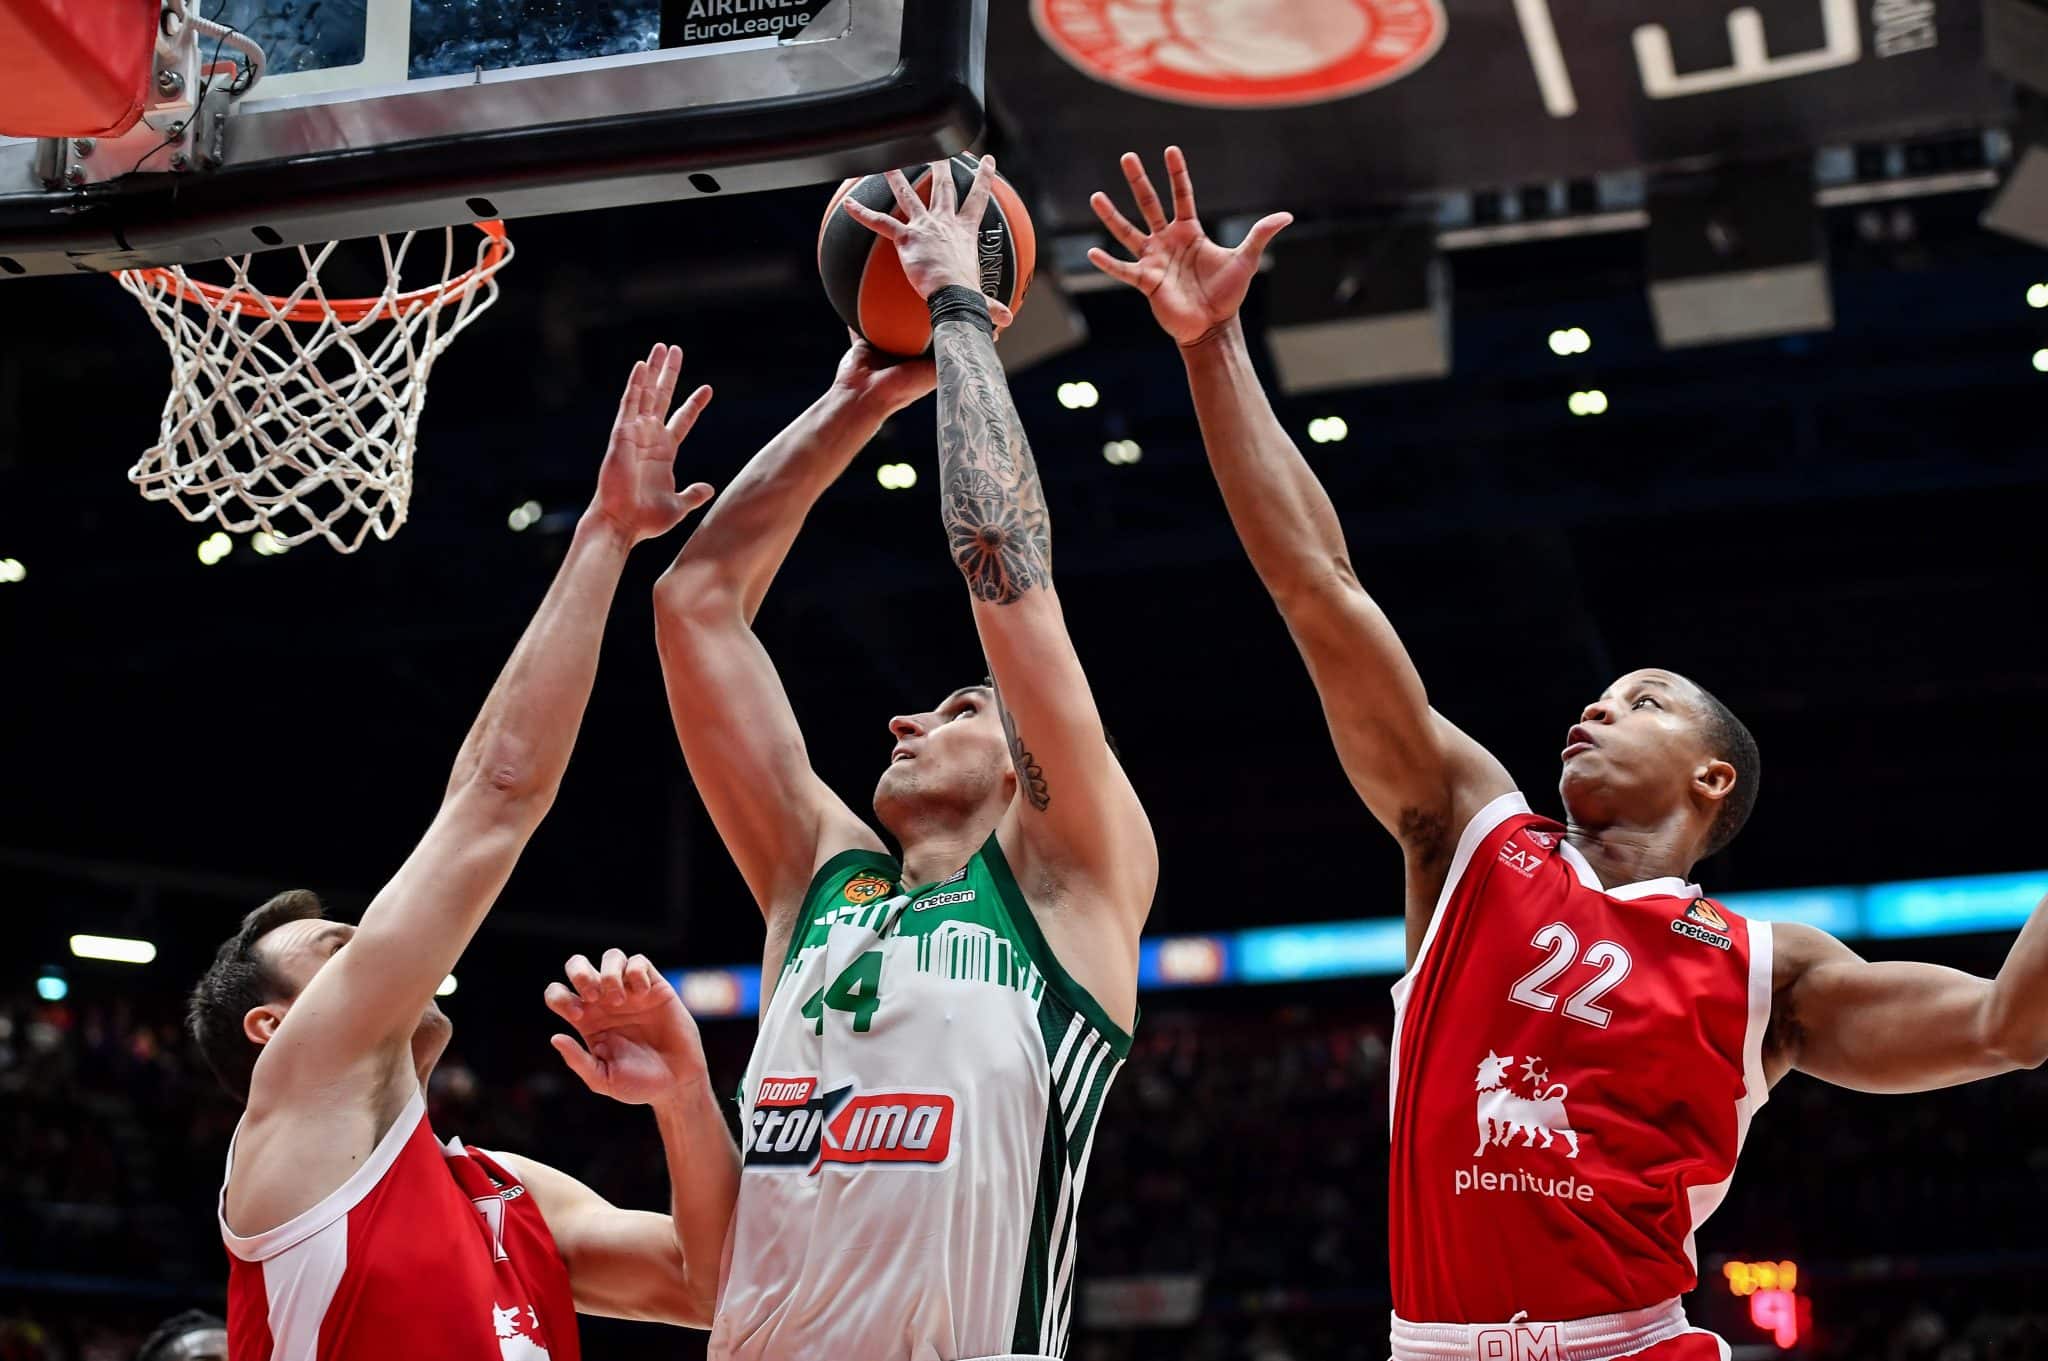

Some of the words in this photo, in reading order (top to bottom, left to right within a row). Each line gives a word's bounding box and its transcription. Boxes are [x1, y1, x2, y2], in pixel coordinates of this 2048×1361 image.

[684, 12, 811, 41] EuroLeague
[1500, 840, 1543, 872] EA7
[914, 890, 974, 911] oneteam
[1672, 920, 1732, 949] oneteam
[1509, 921, 1632, 1029] 22
[758, 1082, 810, 1104] pame
[1455, 1165, 1594, 1201] plenitude
